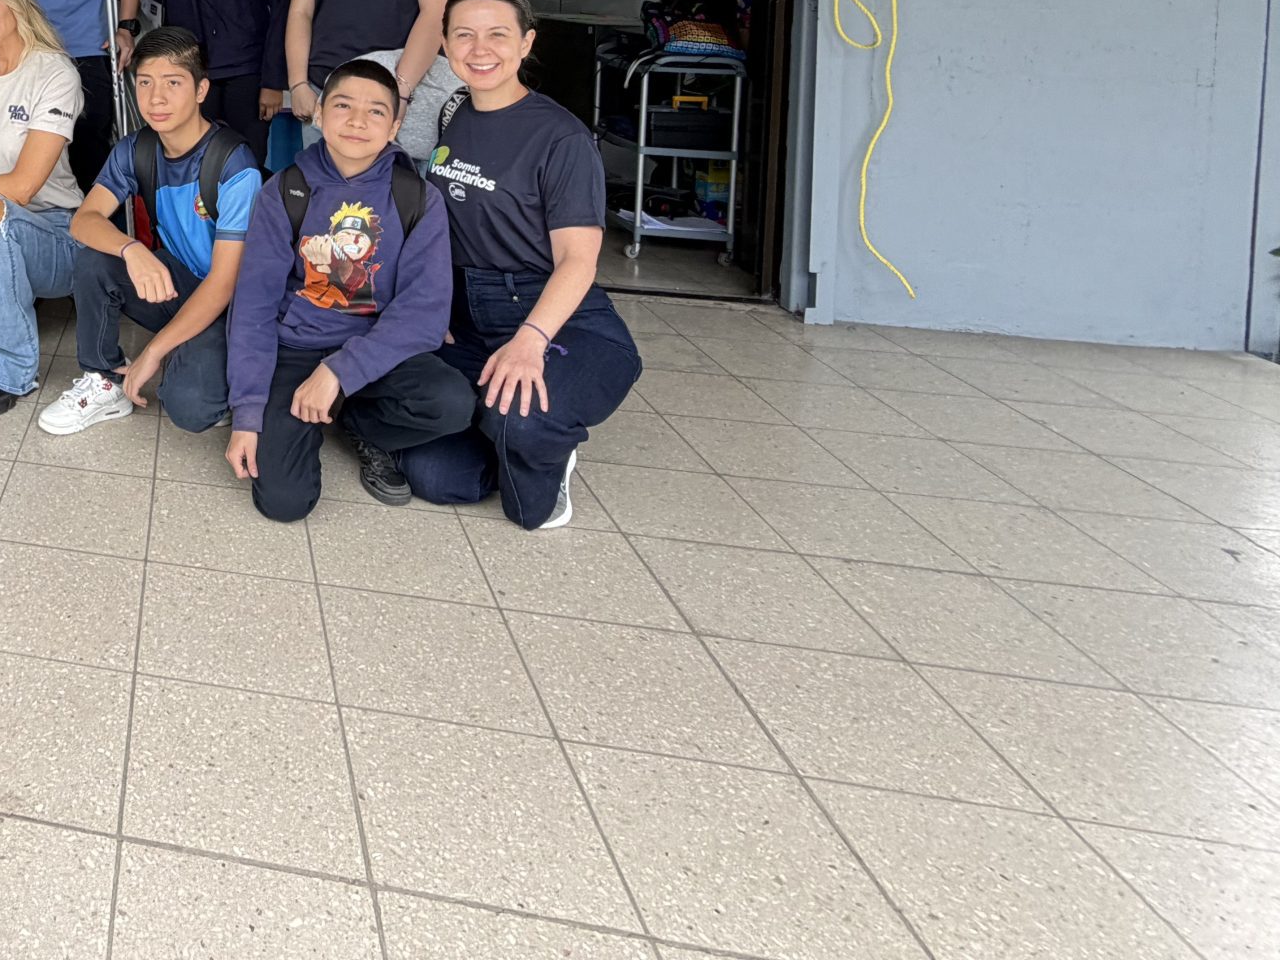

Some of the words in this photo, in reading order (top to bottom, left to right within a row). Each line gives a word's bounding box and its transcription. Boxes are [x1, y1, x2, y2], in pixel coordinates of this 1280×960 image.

[10, 113, 30, 122] RIO
[451, 158, 481, 174] Somos
[431, 163, 497, 192] voluntarios
